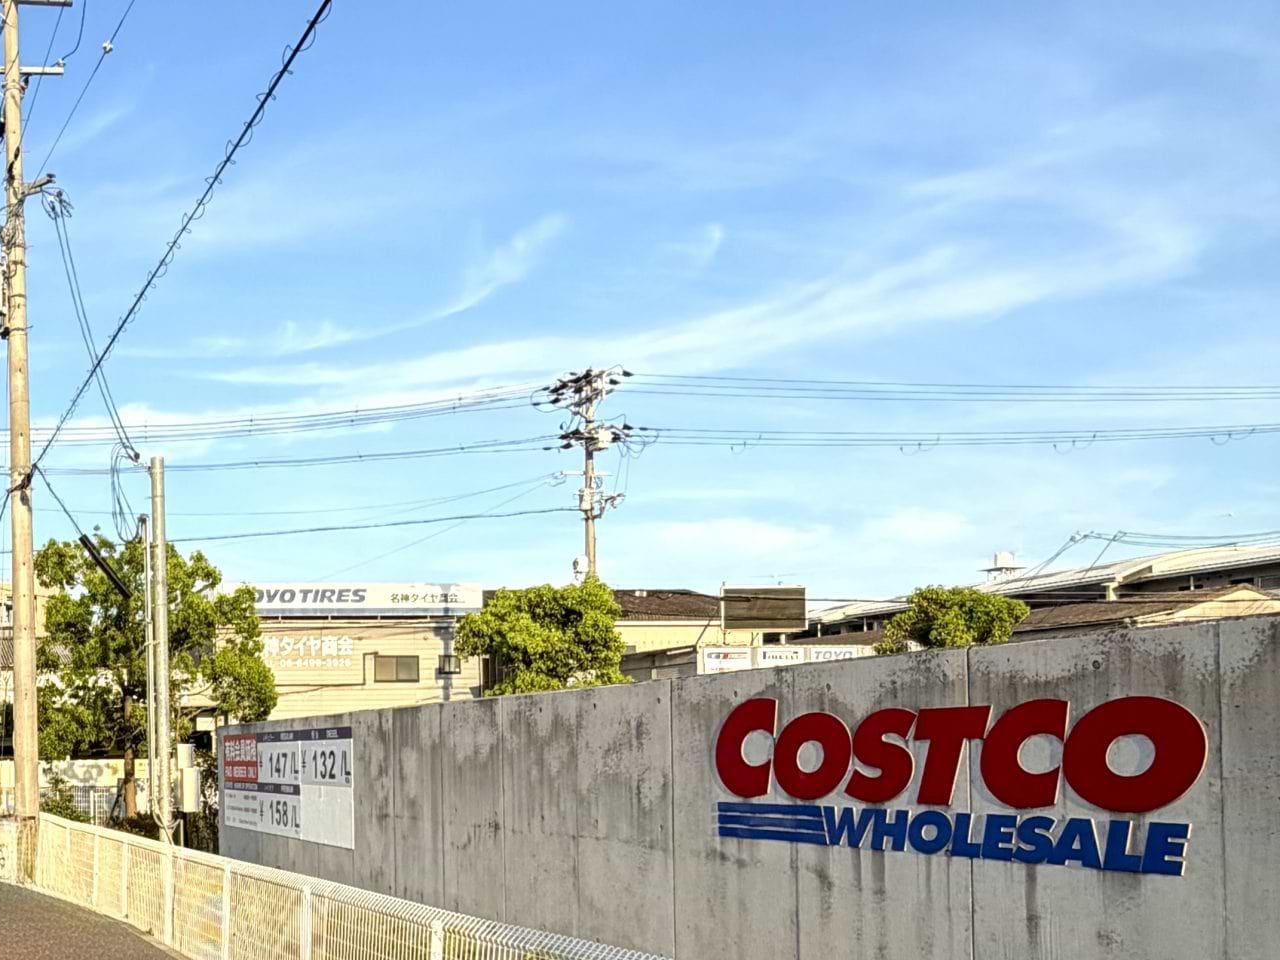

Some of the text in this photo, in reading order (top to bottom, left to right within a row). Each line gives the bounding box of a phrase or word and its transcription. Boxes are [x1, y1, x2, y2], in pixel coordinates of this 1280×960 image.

[254, 588, 367, 604] OYO TIRES
[263, 635, 354, 657] 神タイヤ商会
[814, 650, 853, 660] TOYO
[269, 752, 288, 778] 147
[312, 750, 336, 780] 132
[714, 696, 1208, 813] COSTCO
[269, 799, 288, 828] 158
[823, 805, 1192, 876] WHOLESALE
